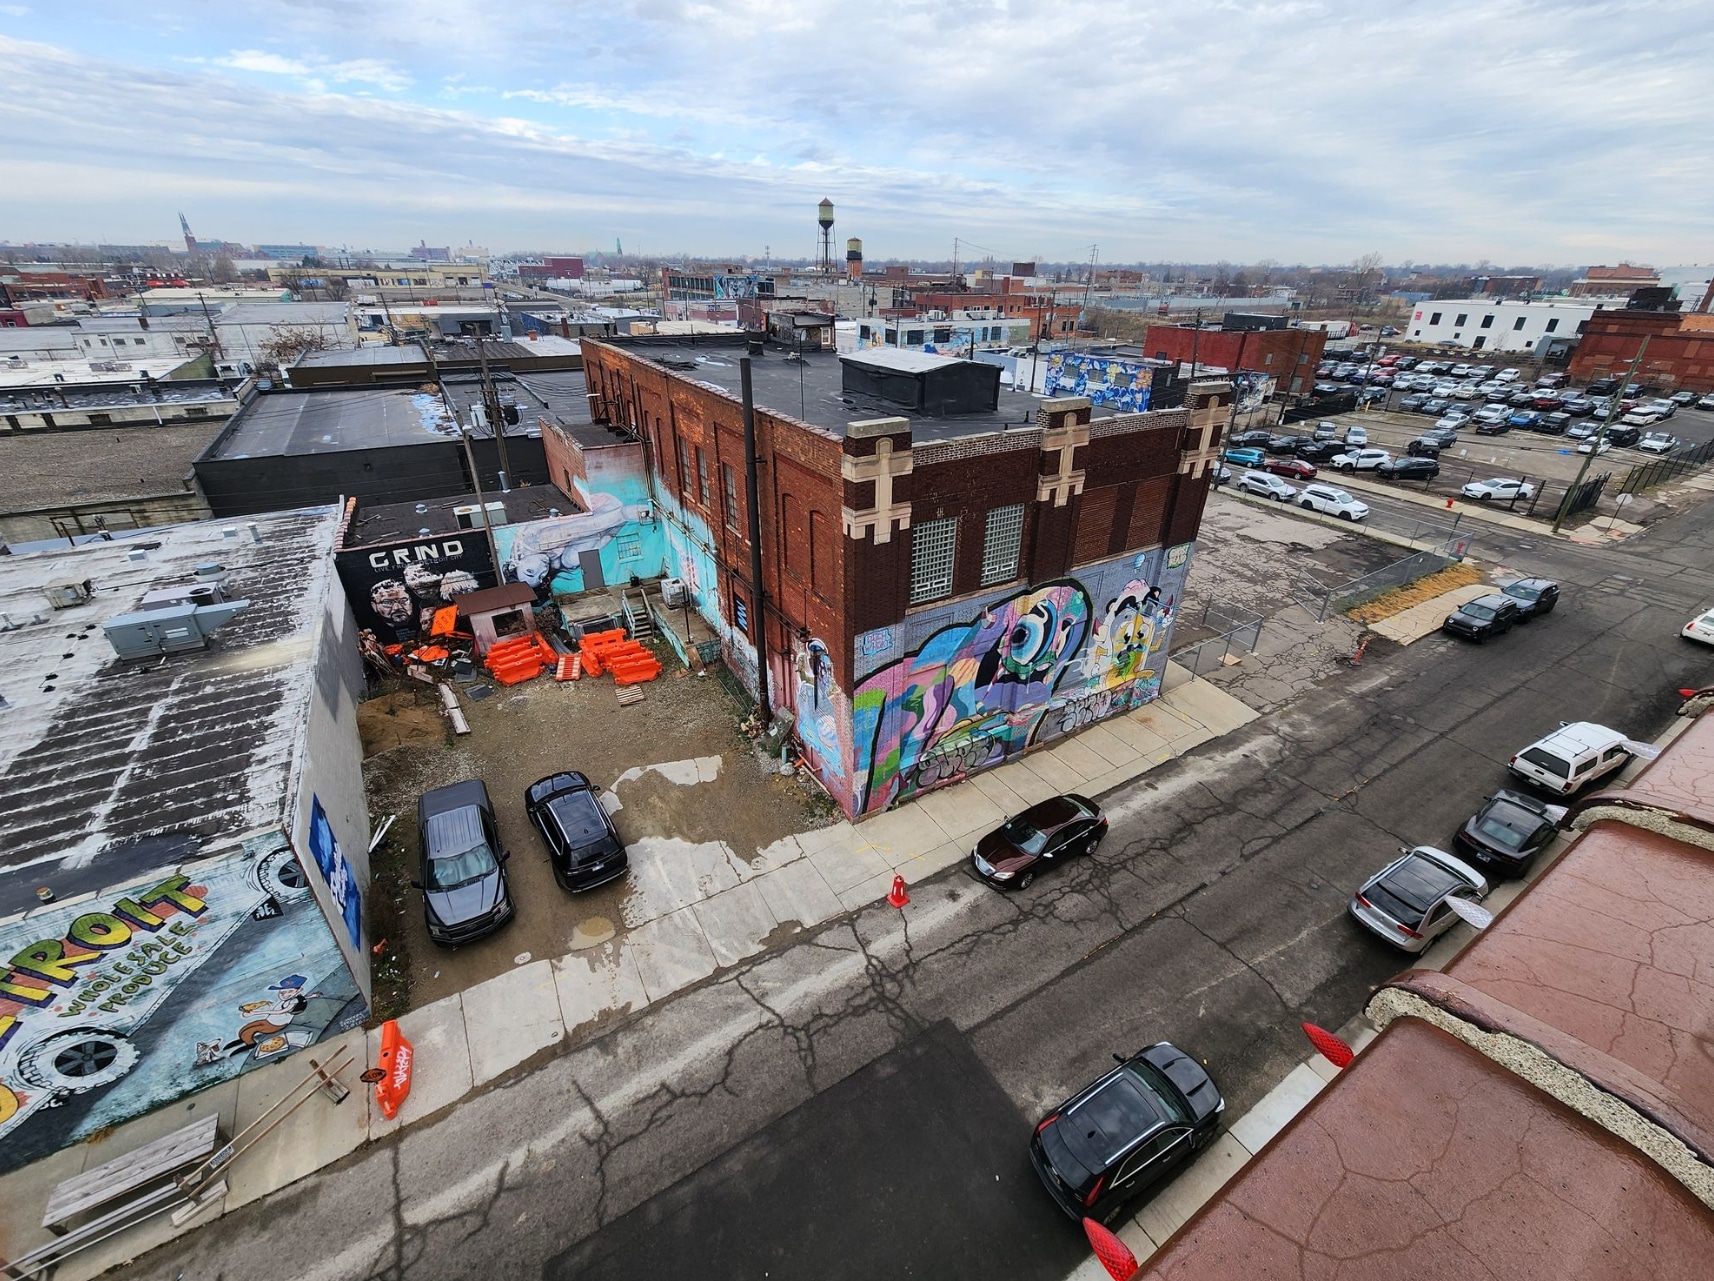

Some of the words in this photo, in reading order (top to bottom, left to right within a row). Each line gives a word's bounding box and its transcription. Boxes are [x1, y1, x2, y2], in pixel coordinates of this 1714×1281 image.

[369, 540, 464, 568] GRIND
[0, 873, 210, 1050] TROIT
[57, 920, 196, 1018] WHOLESALE
[97, 941, 194, 1013] PRODUCE
